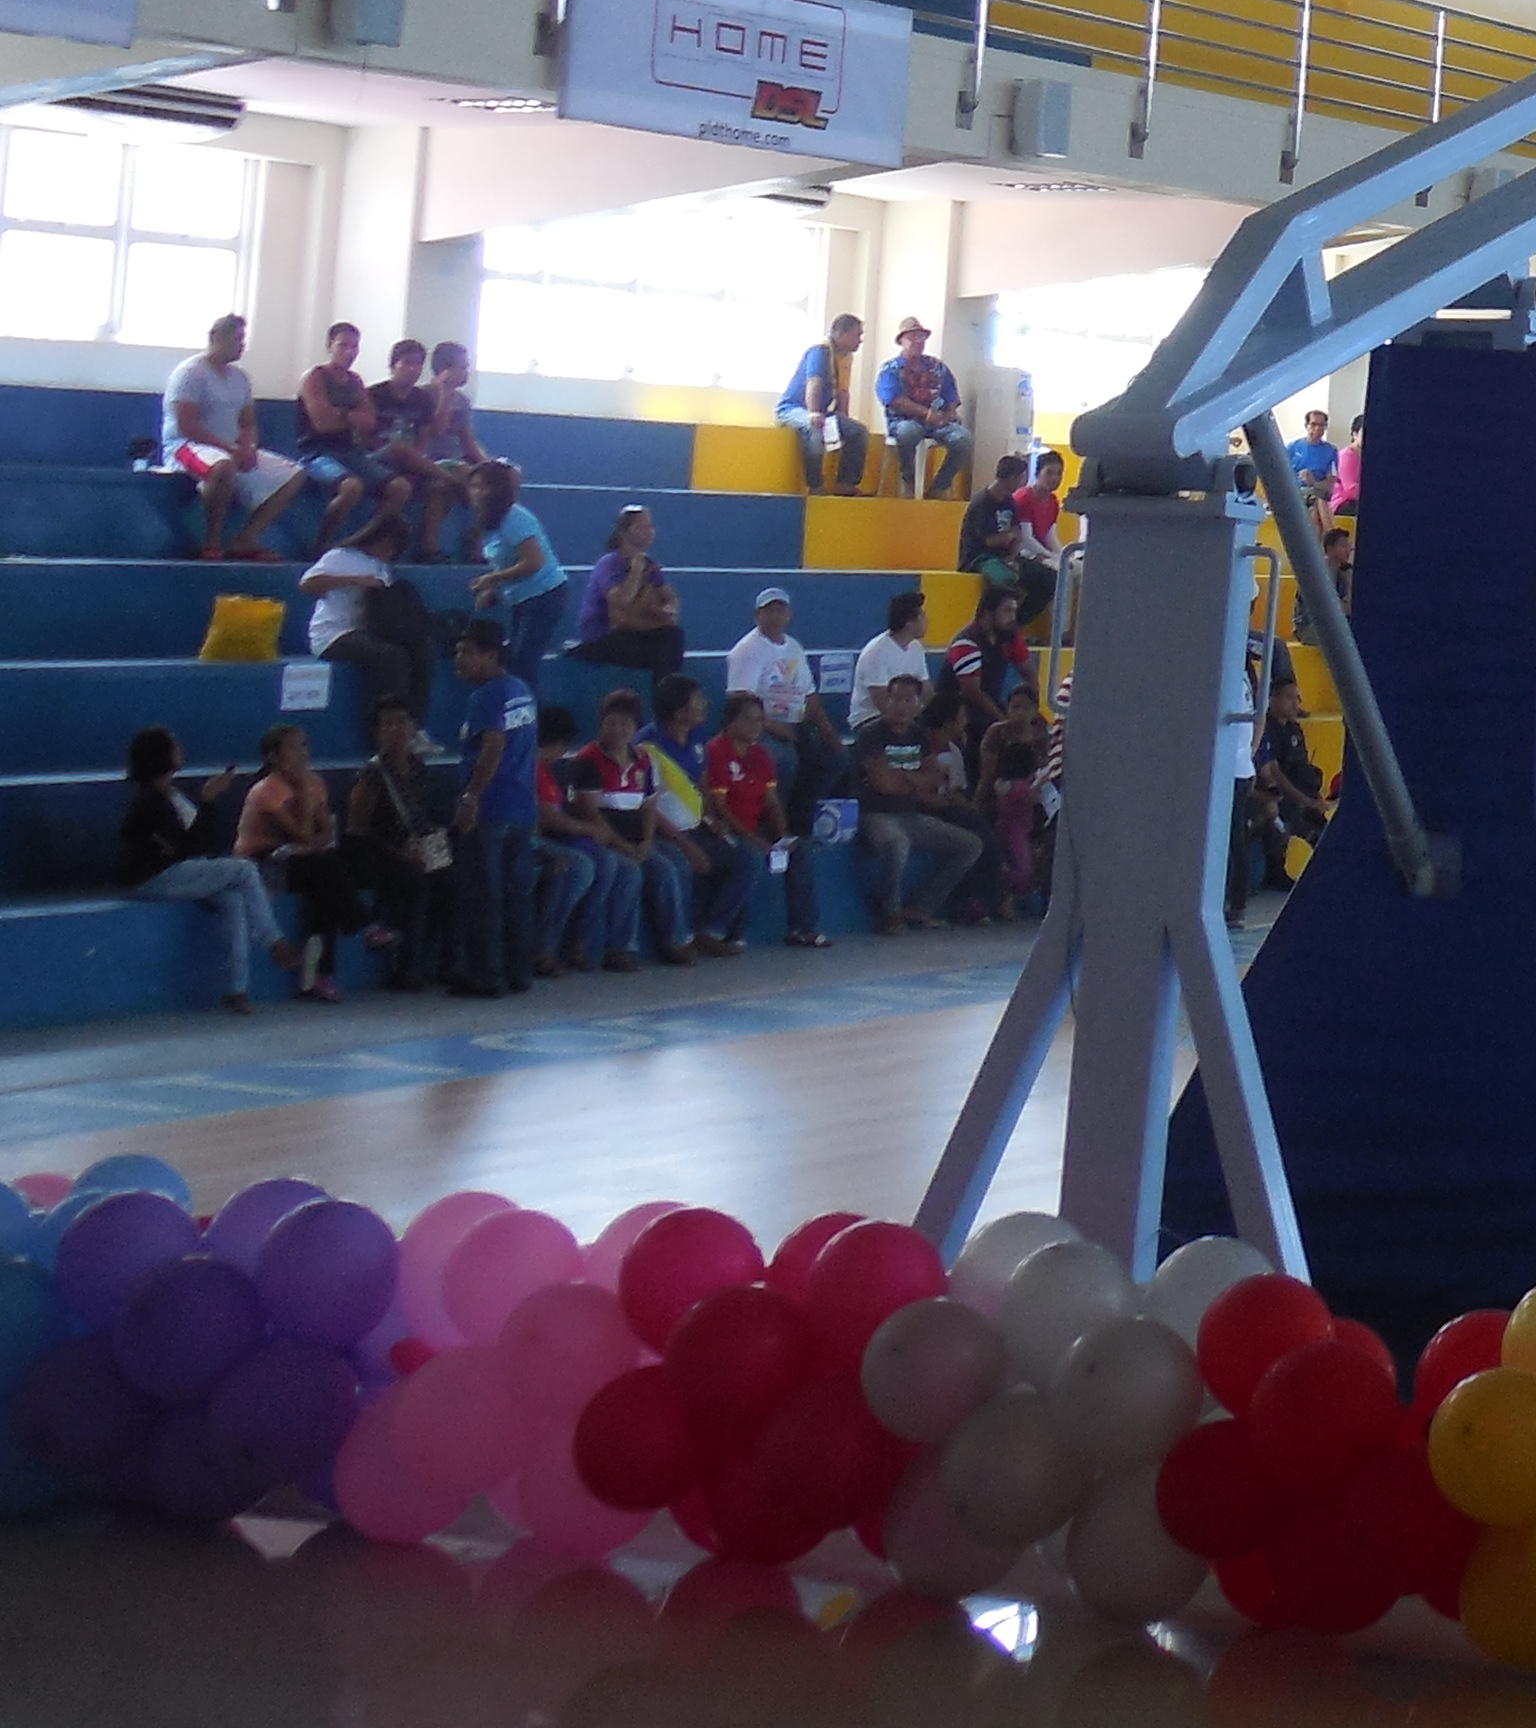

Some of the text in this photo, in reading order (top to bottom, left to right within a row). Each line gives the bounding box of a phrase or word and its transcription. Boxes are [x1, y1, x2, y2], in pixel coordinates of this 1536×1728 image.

[669, 13, 829, 72] HOME
[751, 79, 829, 131] DSL
[699, 120, 792, 148] pldthome.com
